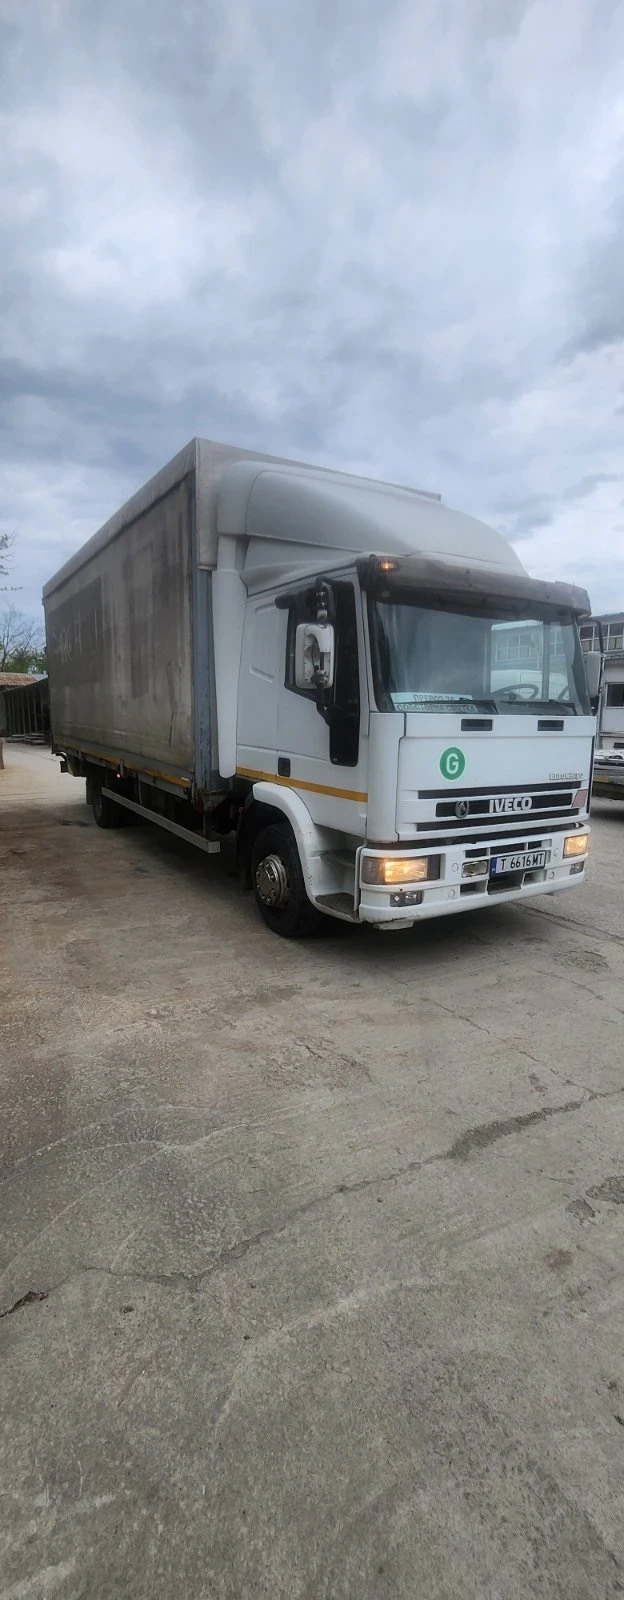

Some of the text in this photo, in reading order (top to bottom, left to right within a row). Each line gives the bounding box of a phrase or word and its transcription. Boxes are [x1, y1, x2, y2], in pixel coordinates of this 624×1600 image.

[446, 753, 459, 774] G
[489, 797, 532, 813] IVECO
[501, 858, 506, 870] T
